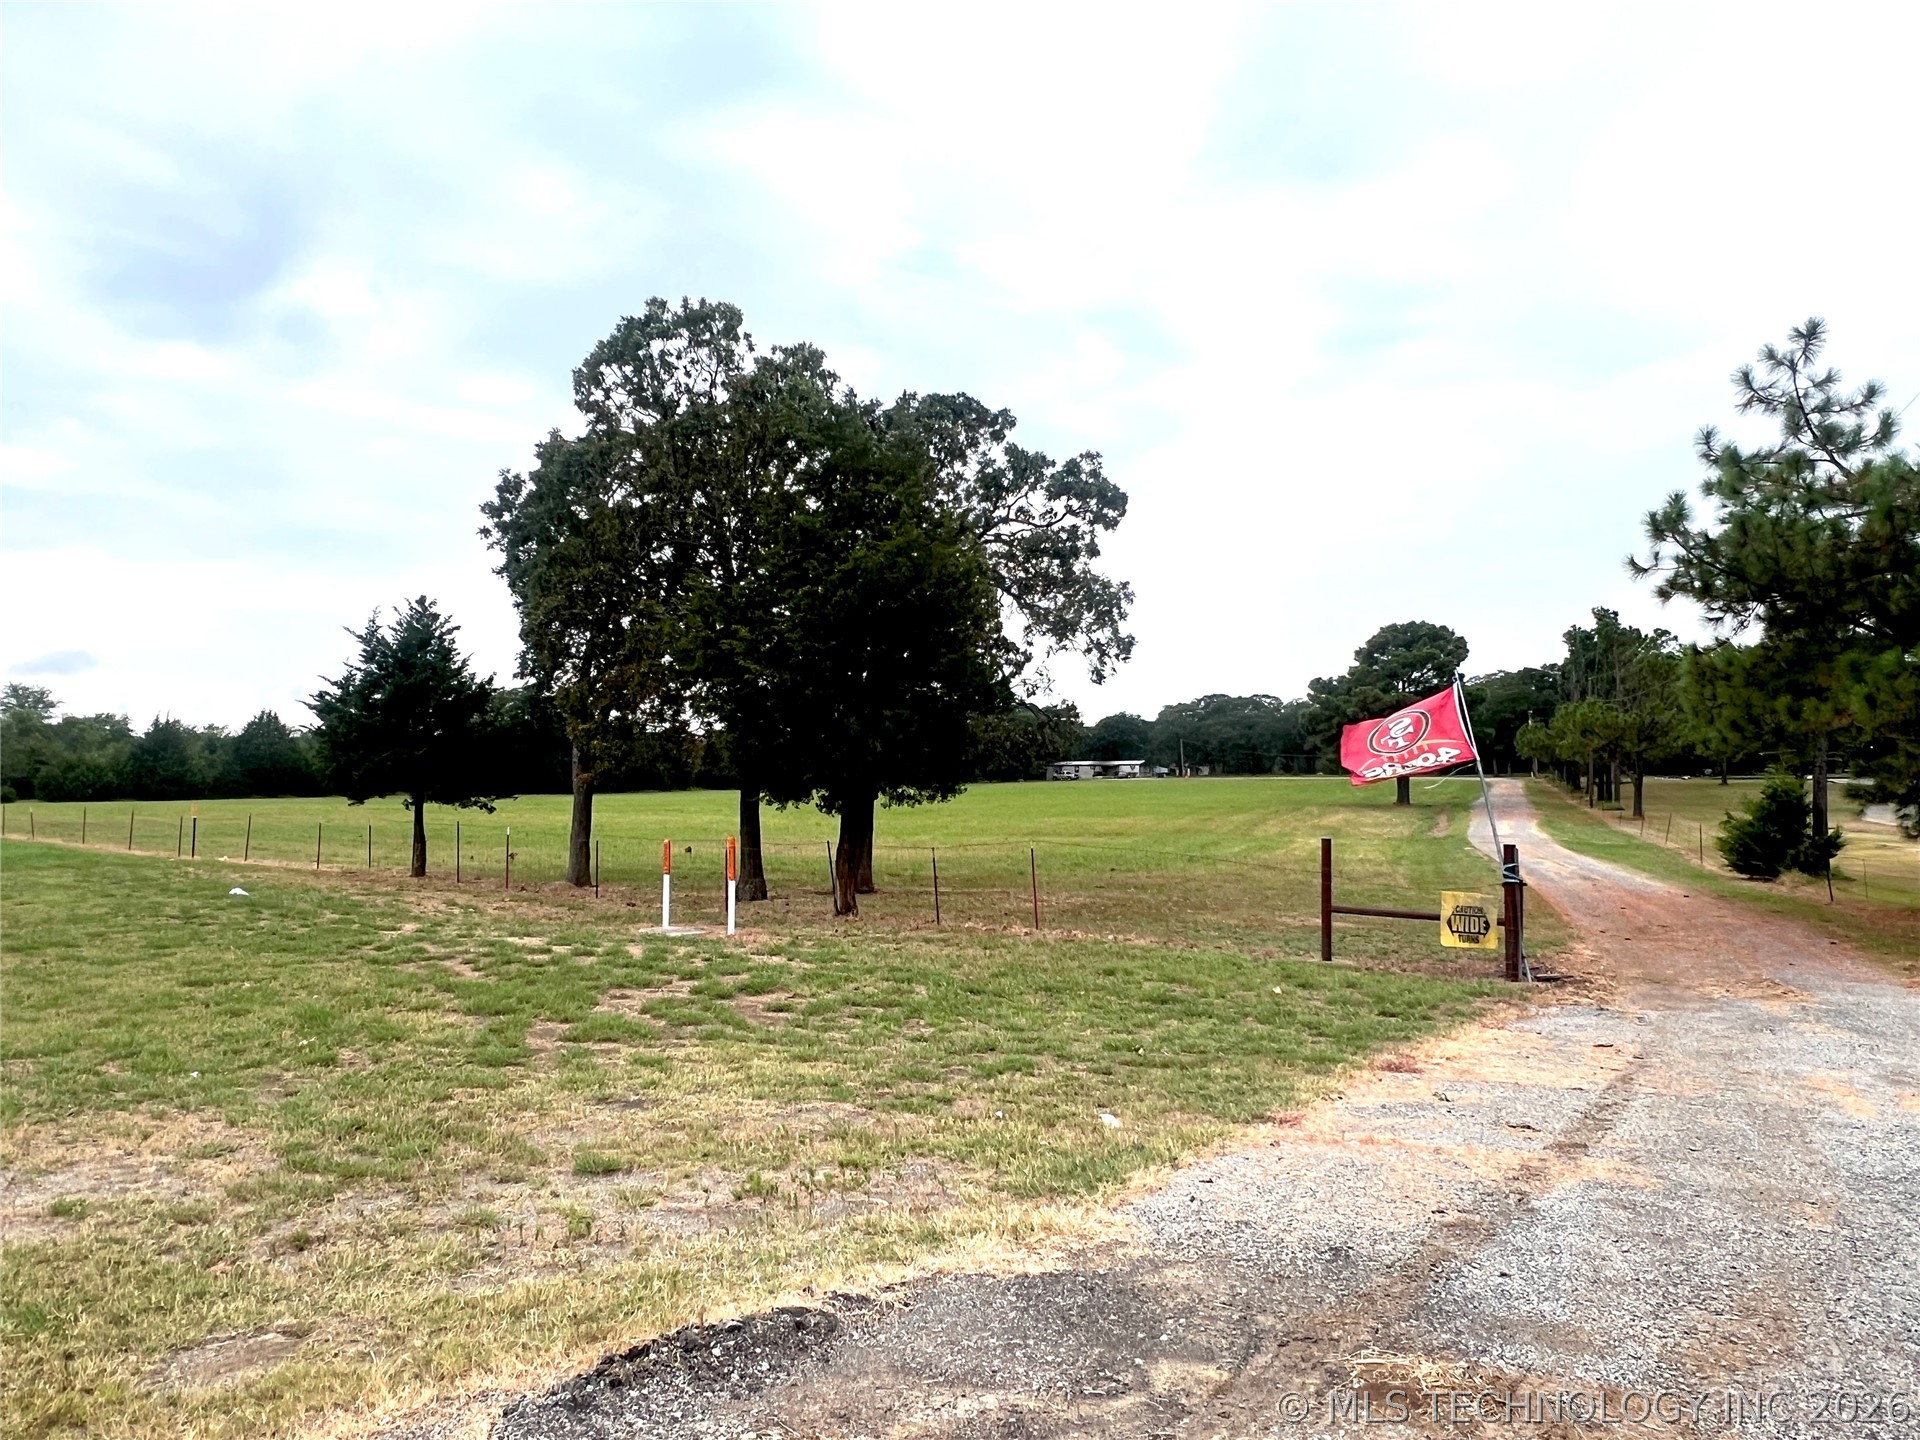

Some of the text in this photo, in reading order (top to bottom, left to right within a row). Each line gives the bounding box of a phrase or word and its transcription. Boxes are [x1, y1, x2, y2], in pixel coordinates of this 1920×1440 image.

[1455, 905, 1484, 915] CAUTION
[1450, 915, 1487, 934] WIDE
[1458, 933, 1480, 944] TURNS
